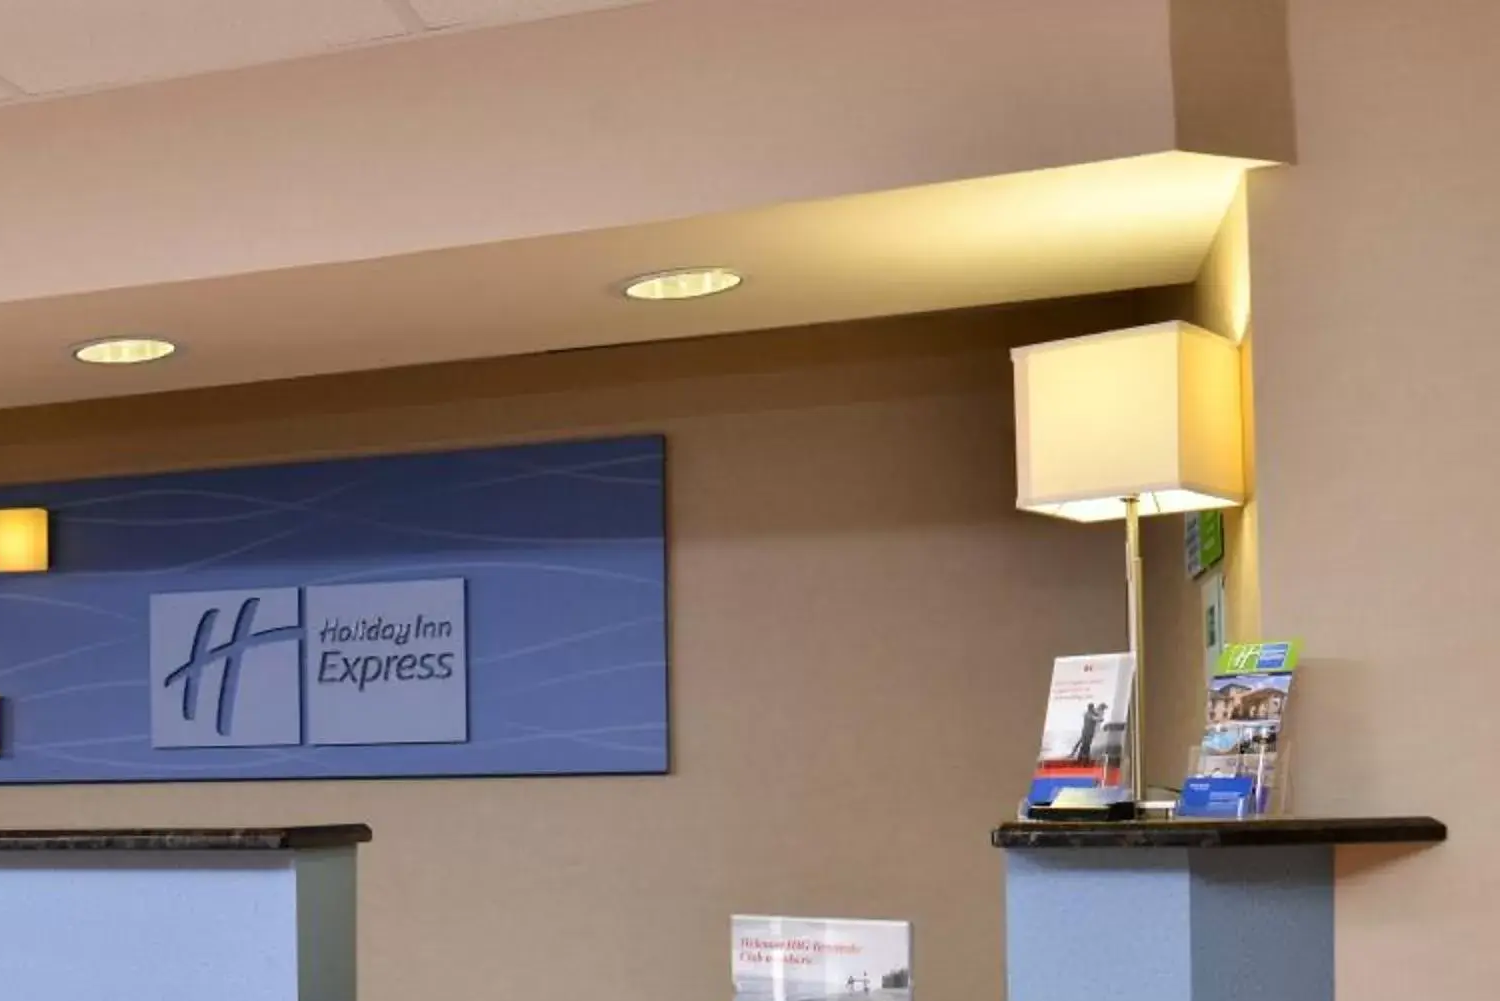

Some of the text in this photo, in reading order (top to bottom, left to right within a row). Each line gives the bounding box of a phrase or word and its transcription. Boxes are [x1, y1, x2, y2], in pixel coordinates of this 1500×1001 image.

[320, 613, 453, 645] Holiday Inn
[317, 650, 455, 692] Express
